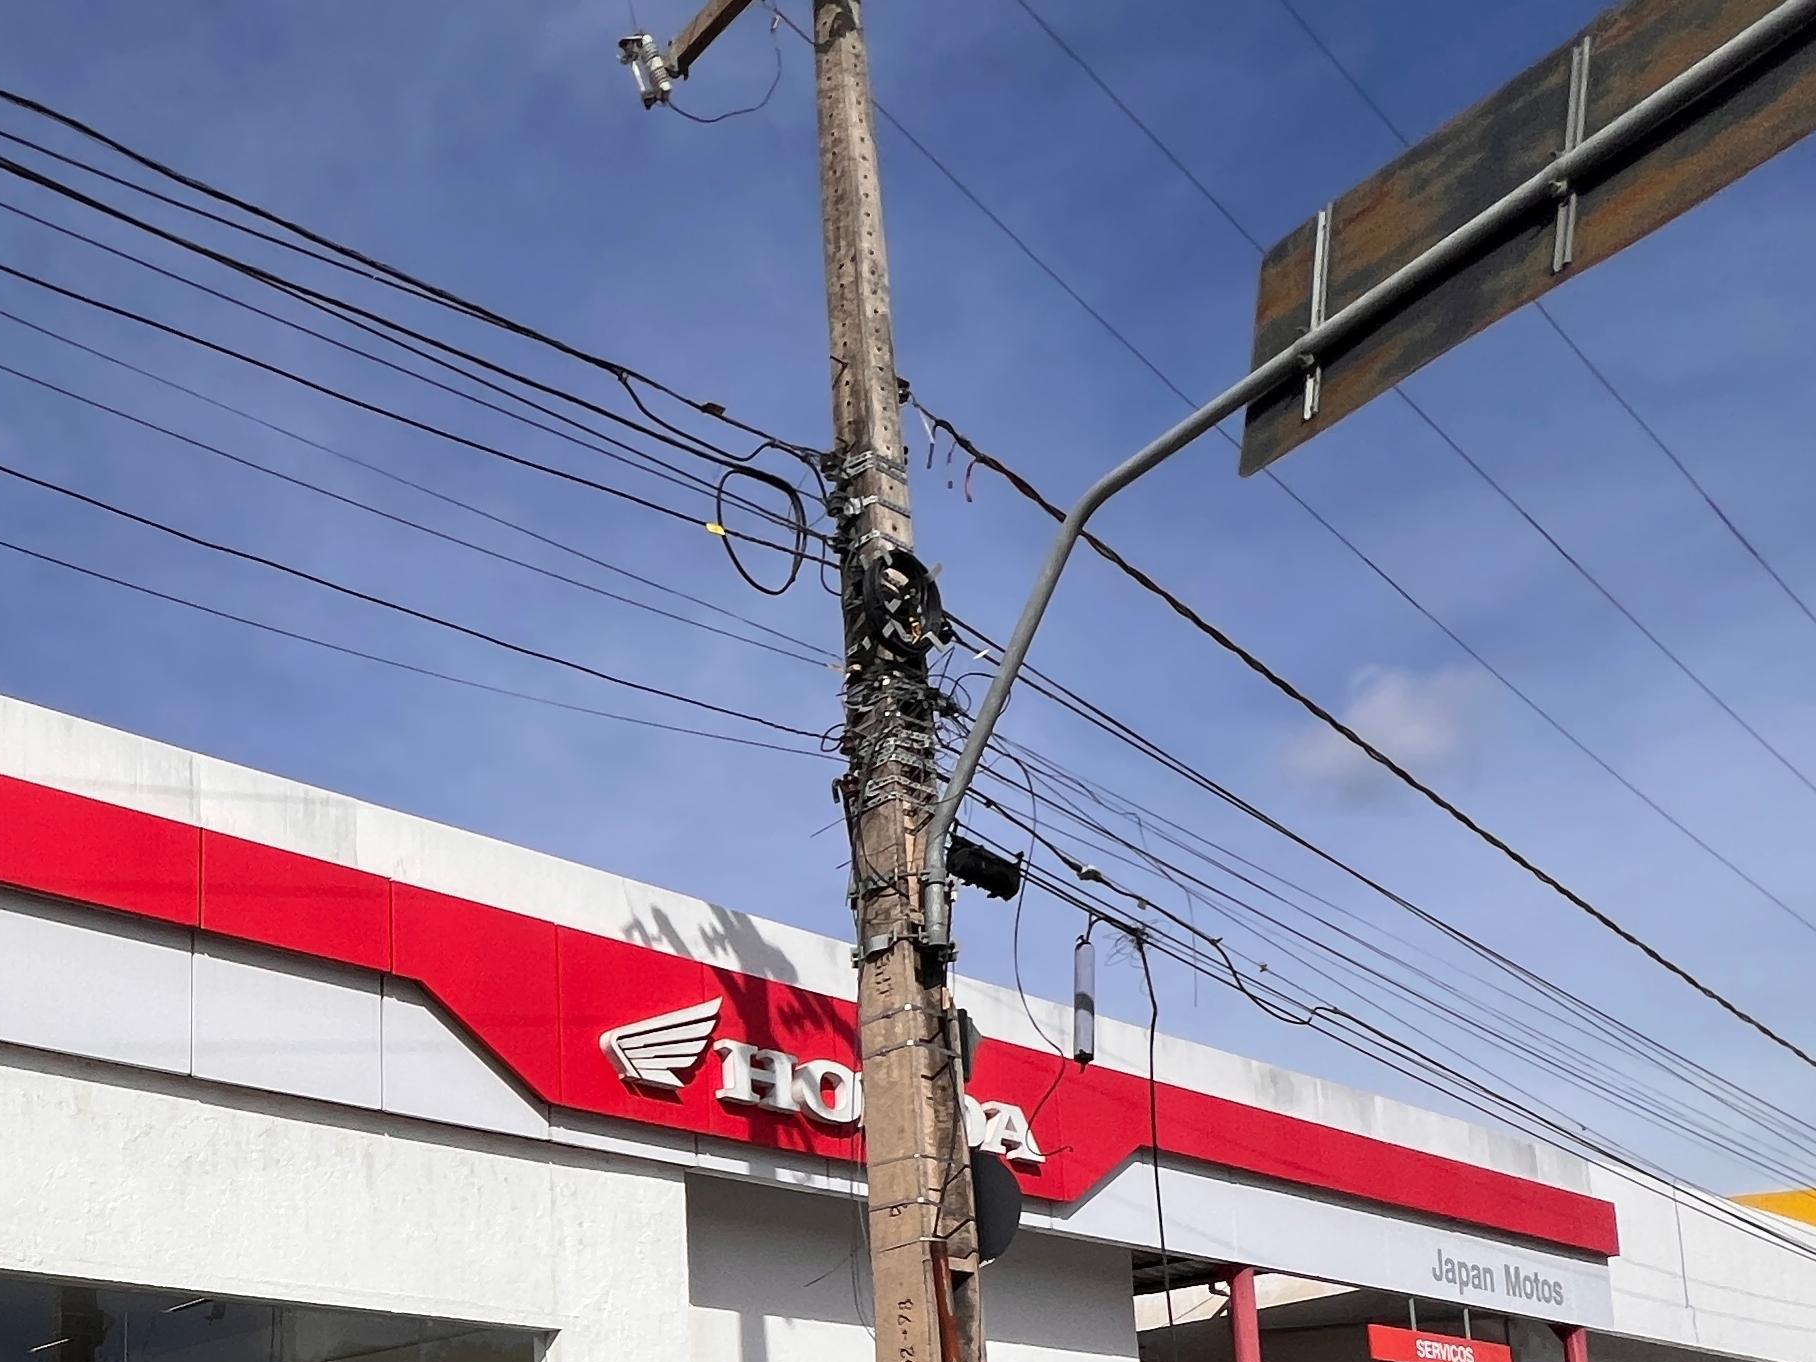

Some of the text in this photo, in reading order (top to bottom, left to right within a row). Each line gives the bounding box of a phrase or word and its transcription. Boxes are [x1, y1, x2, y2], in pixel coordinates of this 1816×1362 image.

[713, 1038, 1046, 1163] HOA
[1432, 1248, 1564, 1306] Japan Motos
